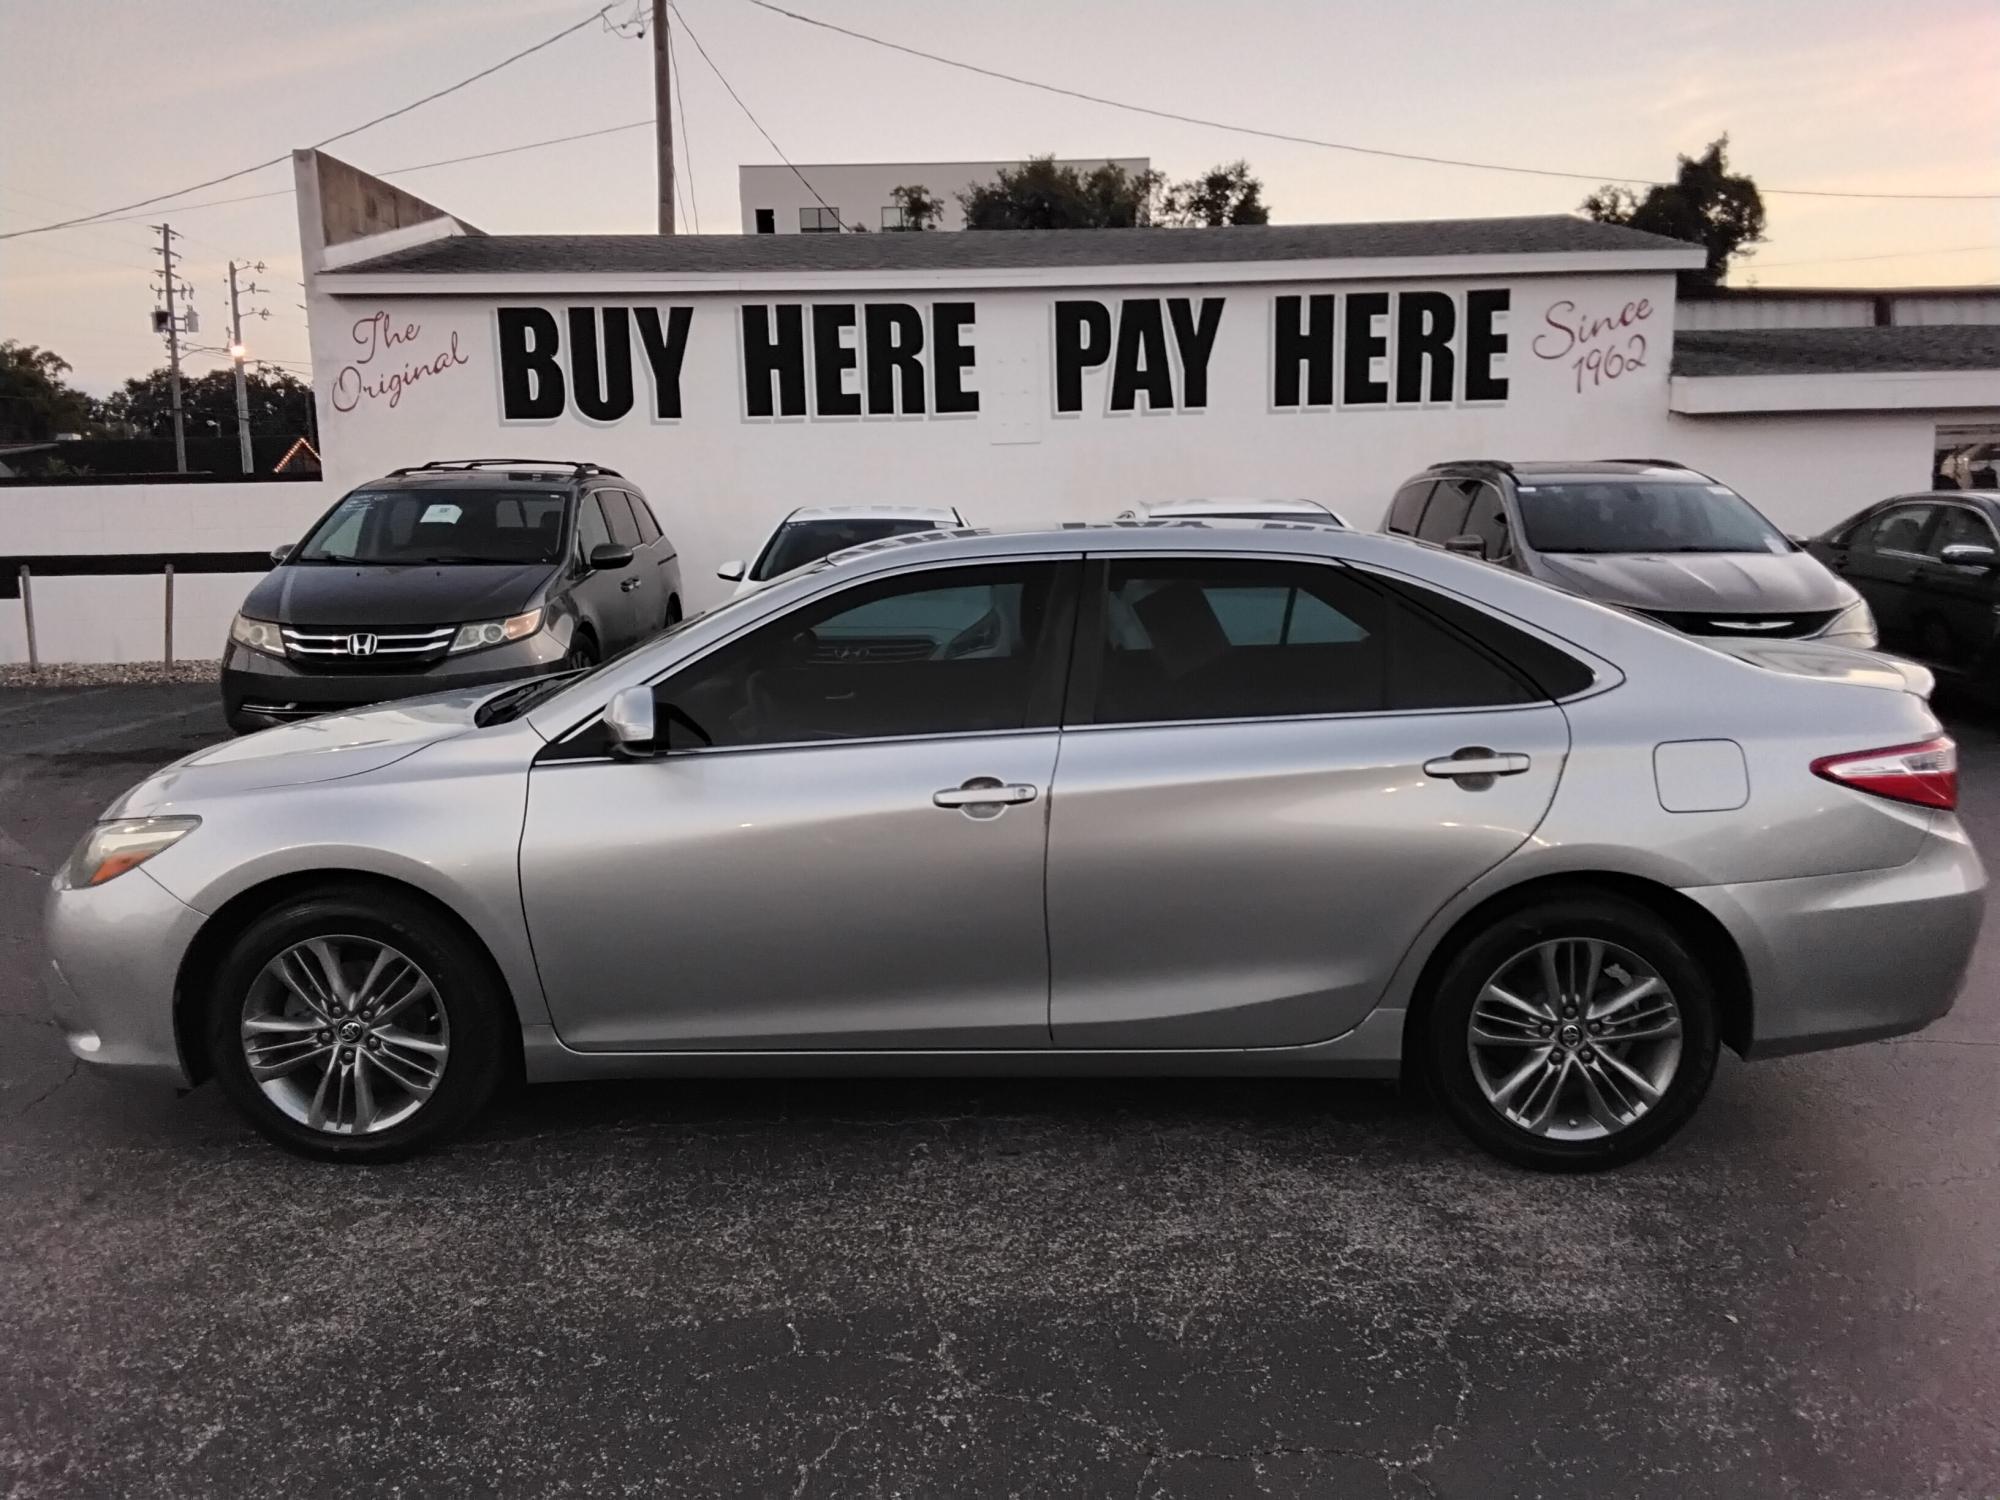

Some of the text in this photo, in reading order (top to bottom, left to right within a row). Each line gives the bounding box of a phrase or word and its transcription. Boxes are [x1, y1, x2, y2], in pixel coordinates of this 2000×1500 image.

[352, 311, 421, 365] The
[498, 289, 1511, 421] BUY HERE PAY HERE
[1532, 298, 1654, 360] Since
[331, 331, 469, 413] Original
[1571, 333, 1647, 394] 1962
